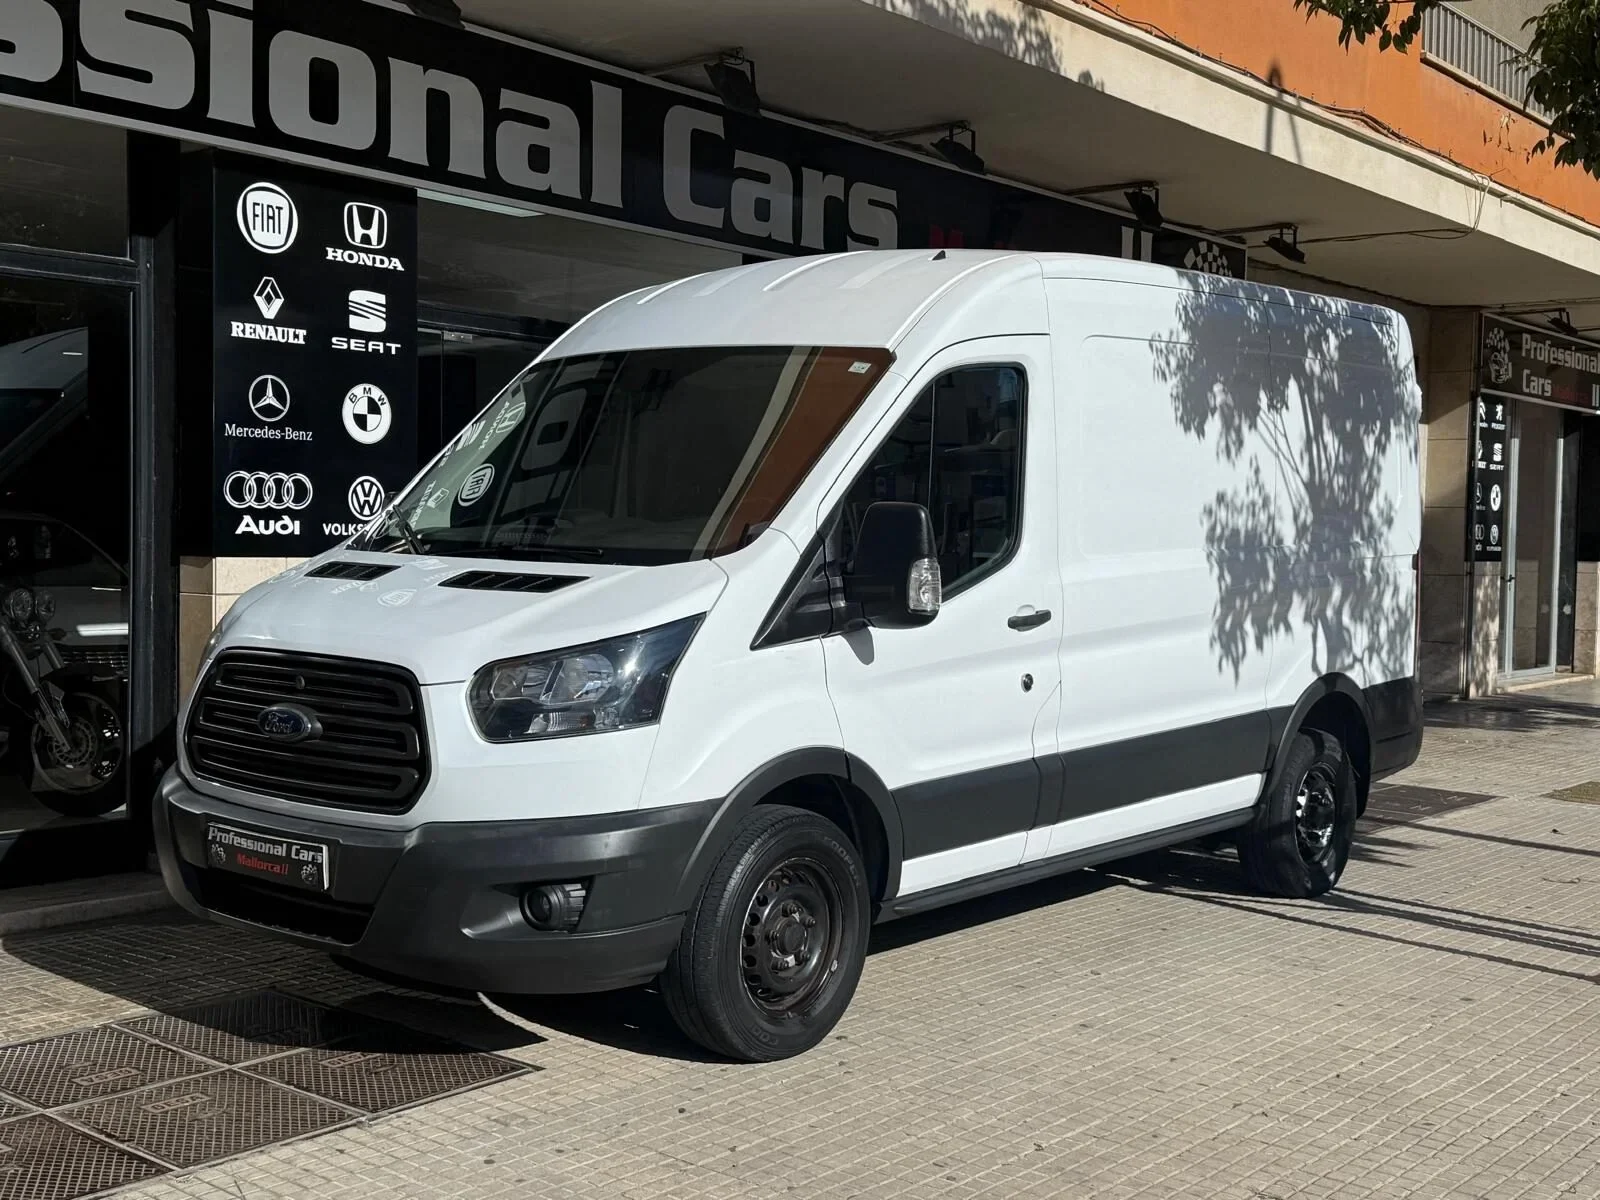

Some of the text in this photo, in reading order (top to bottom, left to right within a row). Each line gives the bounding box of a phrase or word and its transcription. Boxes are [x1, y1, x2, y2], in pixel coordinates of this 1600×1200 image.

[663, 103, 899, 252] Cars
[252, 202, 284, 235] FIAT
[325, 247, 405, 271] HONDA
[230, 321, 307, 344] RENAULT
[331, 337, 402, 355] SEAT
[1521, 368, 1553, 397] Cars
[224, 423, 313, 441] Mercedes-Benz
[1489, 463, 1504, 471] SEAT
[322, 522, 366, 536] VOLKS
[264, 711, 295, 734] Ford
[207, 826, 324, 864] Professional Cars
